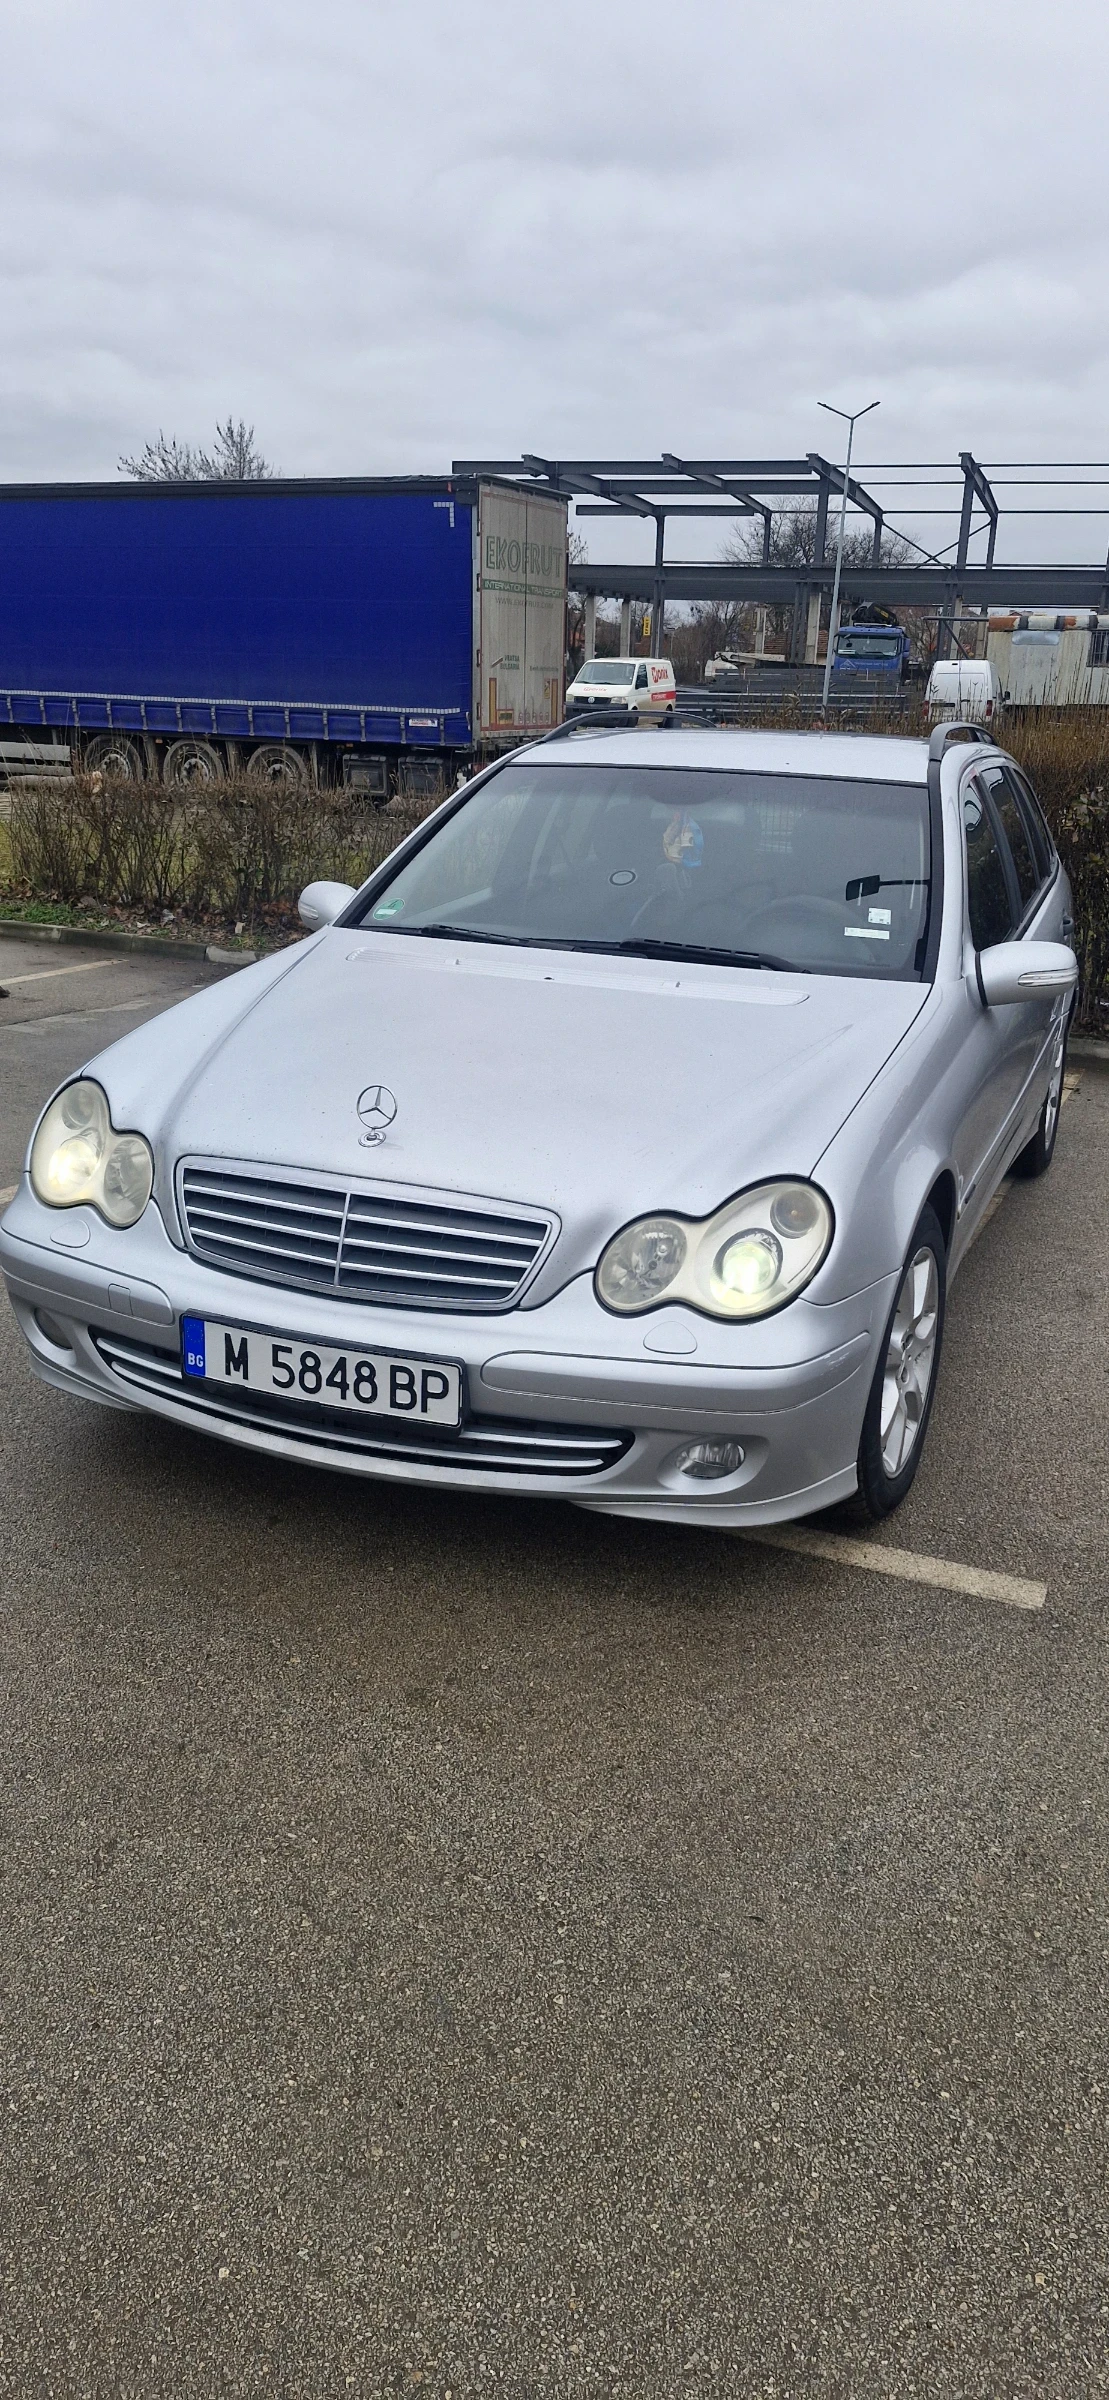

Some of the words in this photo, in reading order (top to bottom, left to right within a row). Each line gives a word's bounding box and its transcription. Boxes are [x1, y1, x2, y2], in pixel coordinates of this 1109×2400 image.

[486, 535, 563, 578] EKOFRUT
[485, 581, 530, 593] INTERNATIONAL
[531, 585, 563, 597] TRANSPORT
[187, 1352, 204, 1368] BG
[224, 1332, 249, 1380] M
[272, 1343, 378, 1404] 5848
[389, 1364, 450, 1413] BP
